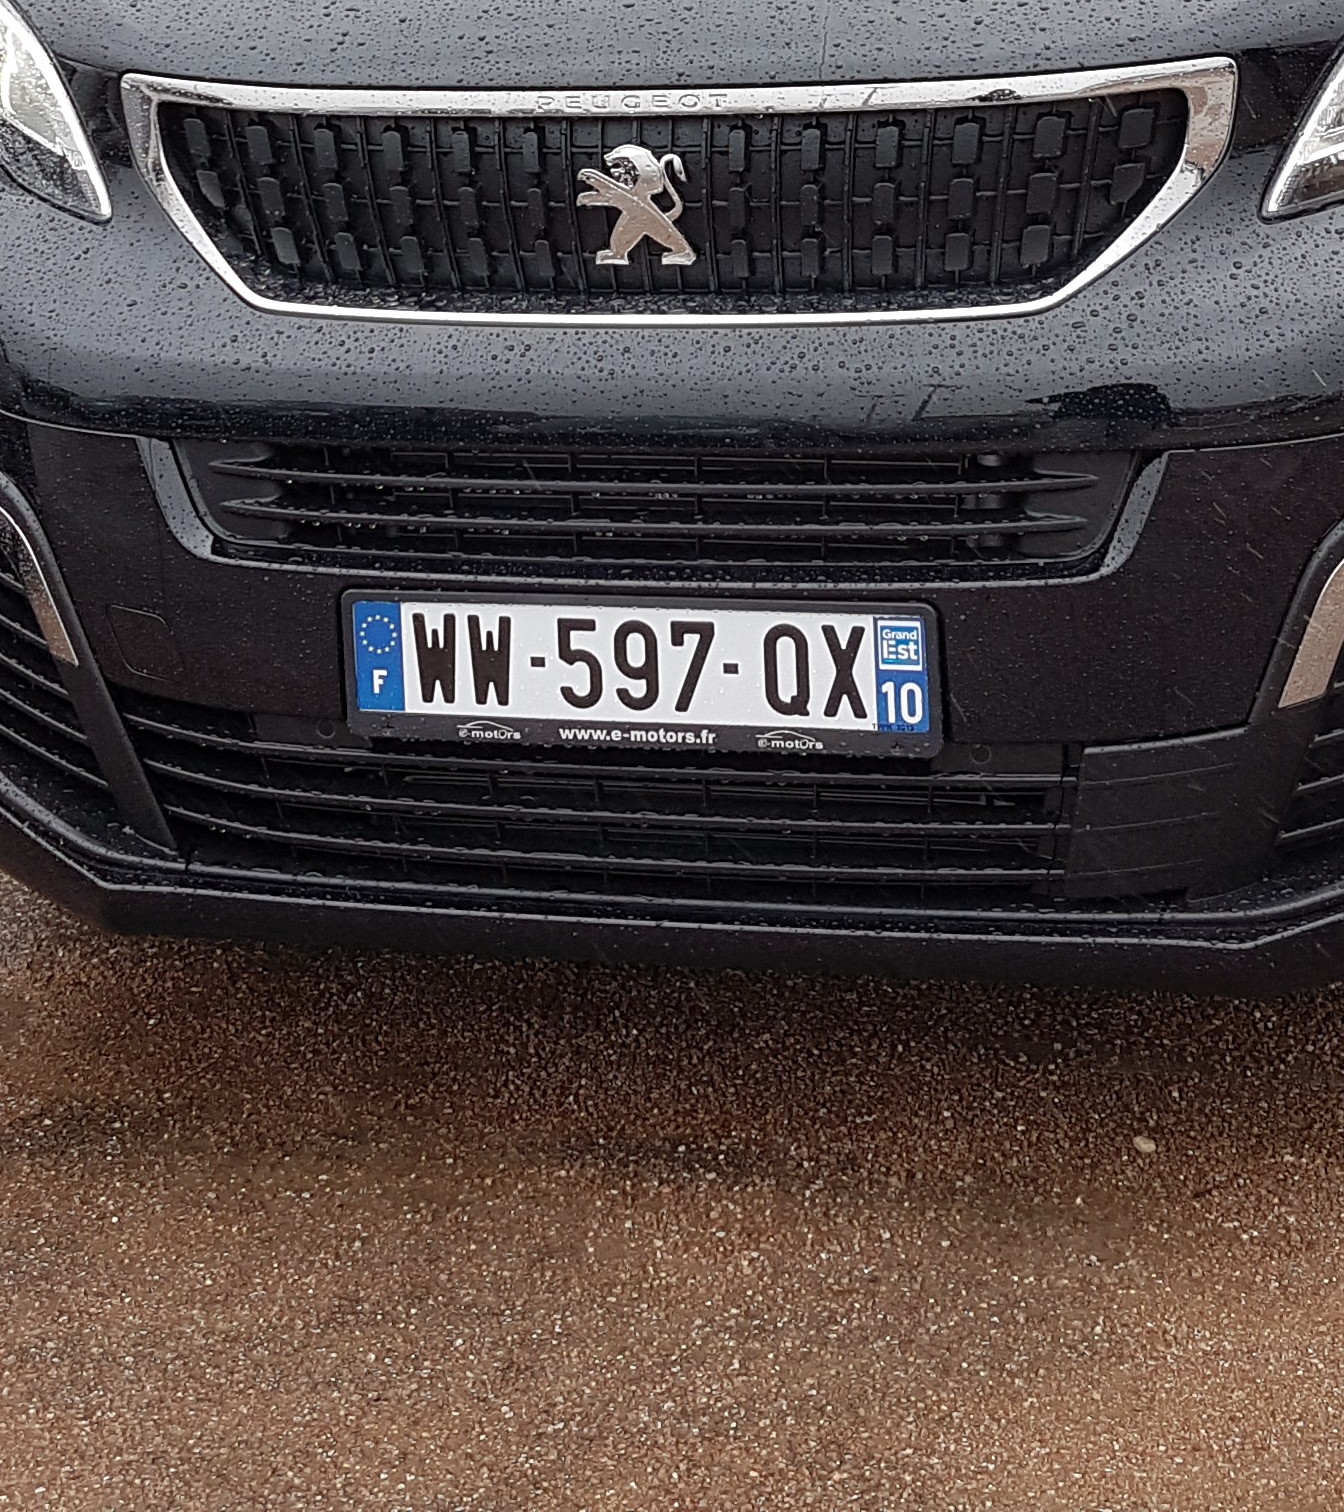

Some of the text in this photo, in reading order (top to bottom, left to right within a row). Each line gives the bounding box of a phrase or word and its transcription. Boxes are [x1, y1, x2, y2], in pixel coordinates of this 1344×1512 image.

[536, 93, 728, 112] PEUGEOT
[882, 628, 918, 640] Grand
[882, 640, 918, 660] Est
[372, 668, 388, 694] F
[881, 681, 923, 724] 10
[558, 726, 717, 745] www.e-motors.fr
